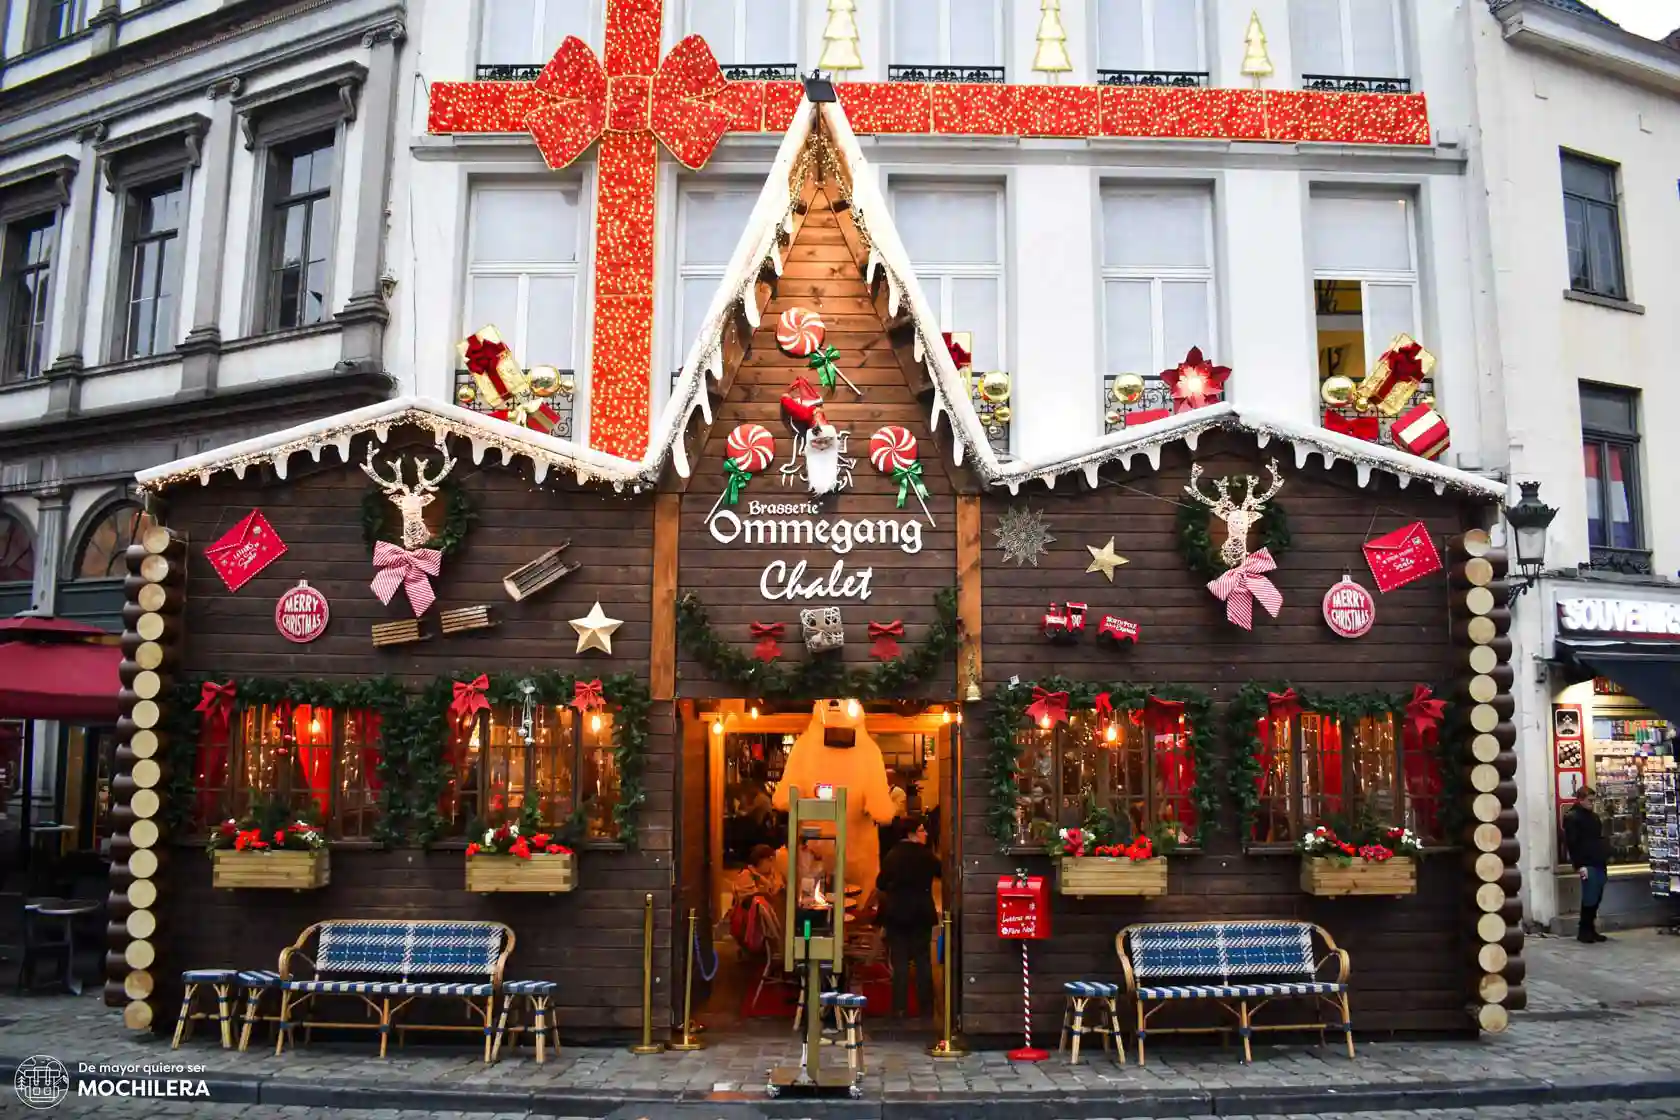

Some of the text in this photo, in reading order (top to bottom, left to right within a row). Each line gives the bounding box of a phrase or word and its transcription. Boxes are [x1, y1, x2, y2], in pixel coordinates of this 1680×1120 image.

[748, 500, 819, 515] Brasserie
[709, 509, 923, 554] Ommegang
[760, 559, 873, 600] Chalet
[284, 594, 319, 613] MERRY
[1332, 589, 1365, 608] MERRY
[282, 614, 321, 636] CHRISTMAS
[1331, 609, 1369, 631] CHRISTMAS
